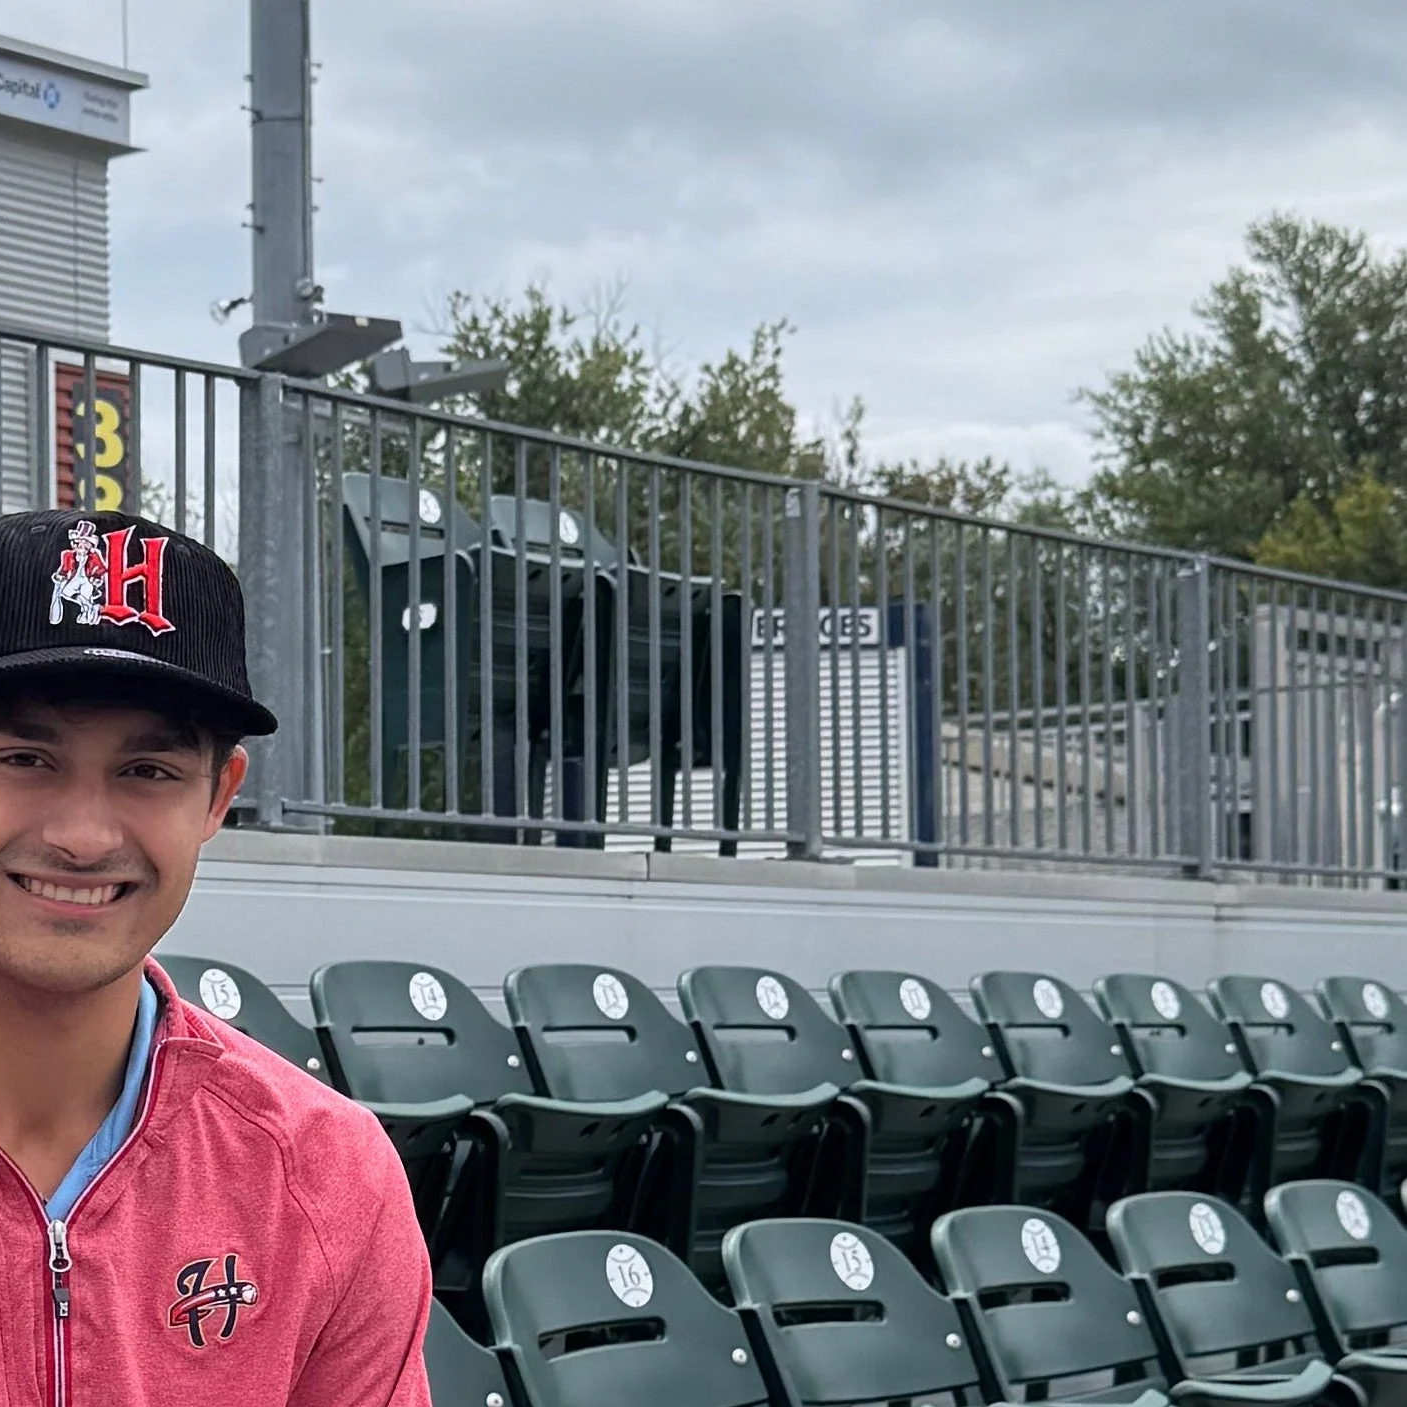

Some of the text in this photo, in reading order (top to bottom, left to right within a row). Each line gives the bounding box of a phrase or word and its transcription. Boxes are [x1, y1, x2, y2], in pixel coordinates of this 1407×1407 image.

[99, 524, 176, 636] H
[211, 984, 229, 1004] 15
[420, 987, 437, 1005] 14
[841, 1250, 861, 1272] 15
[618, 1263, 640, 1288] 16
